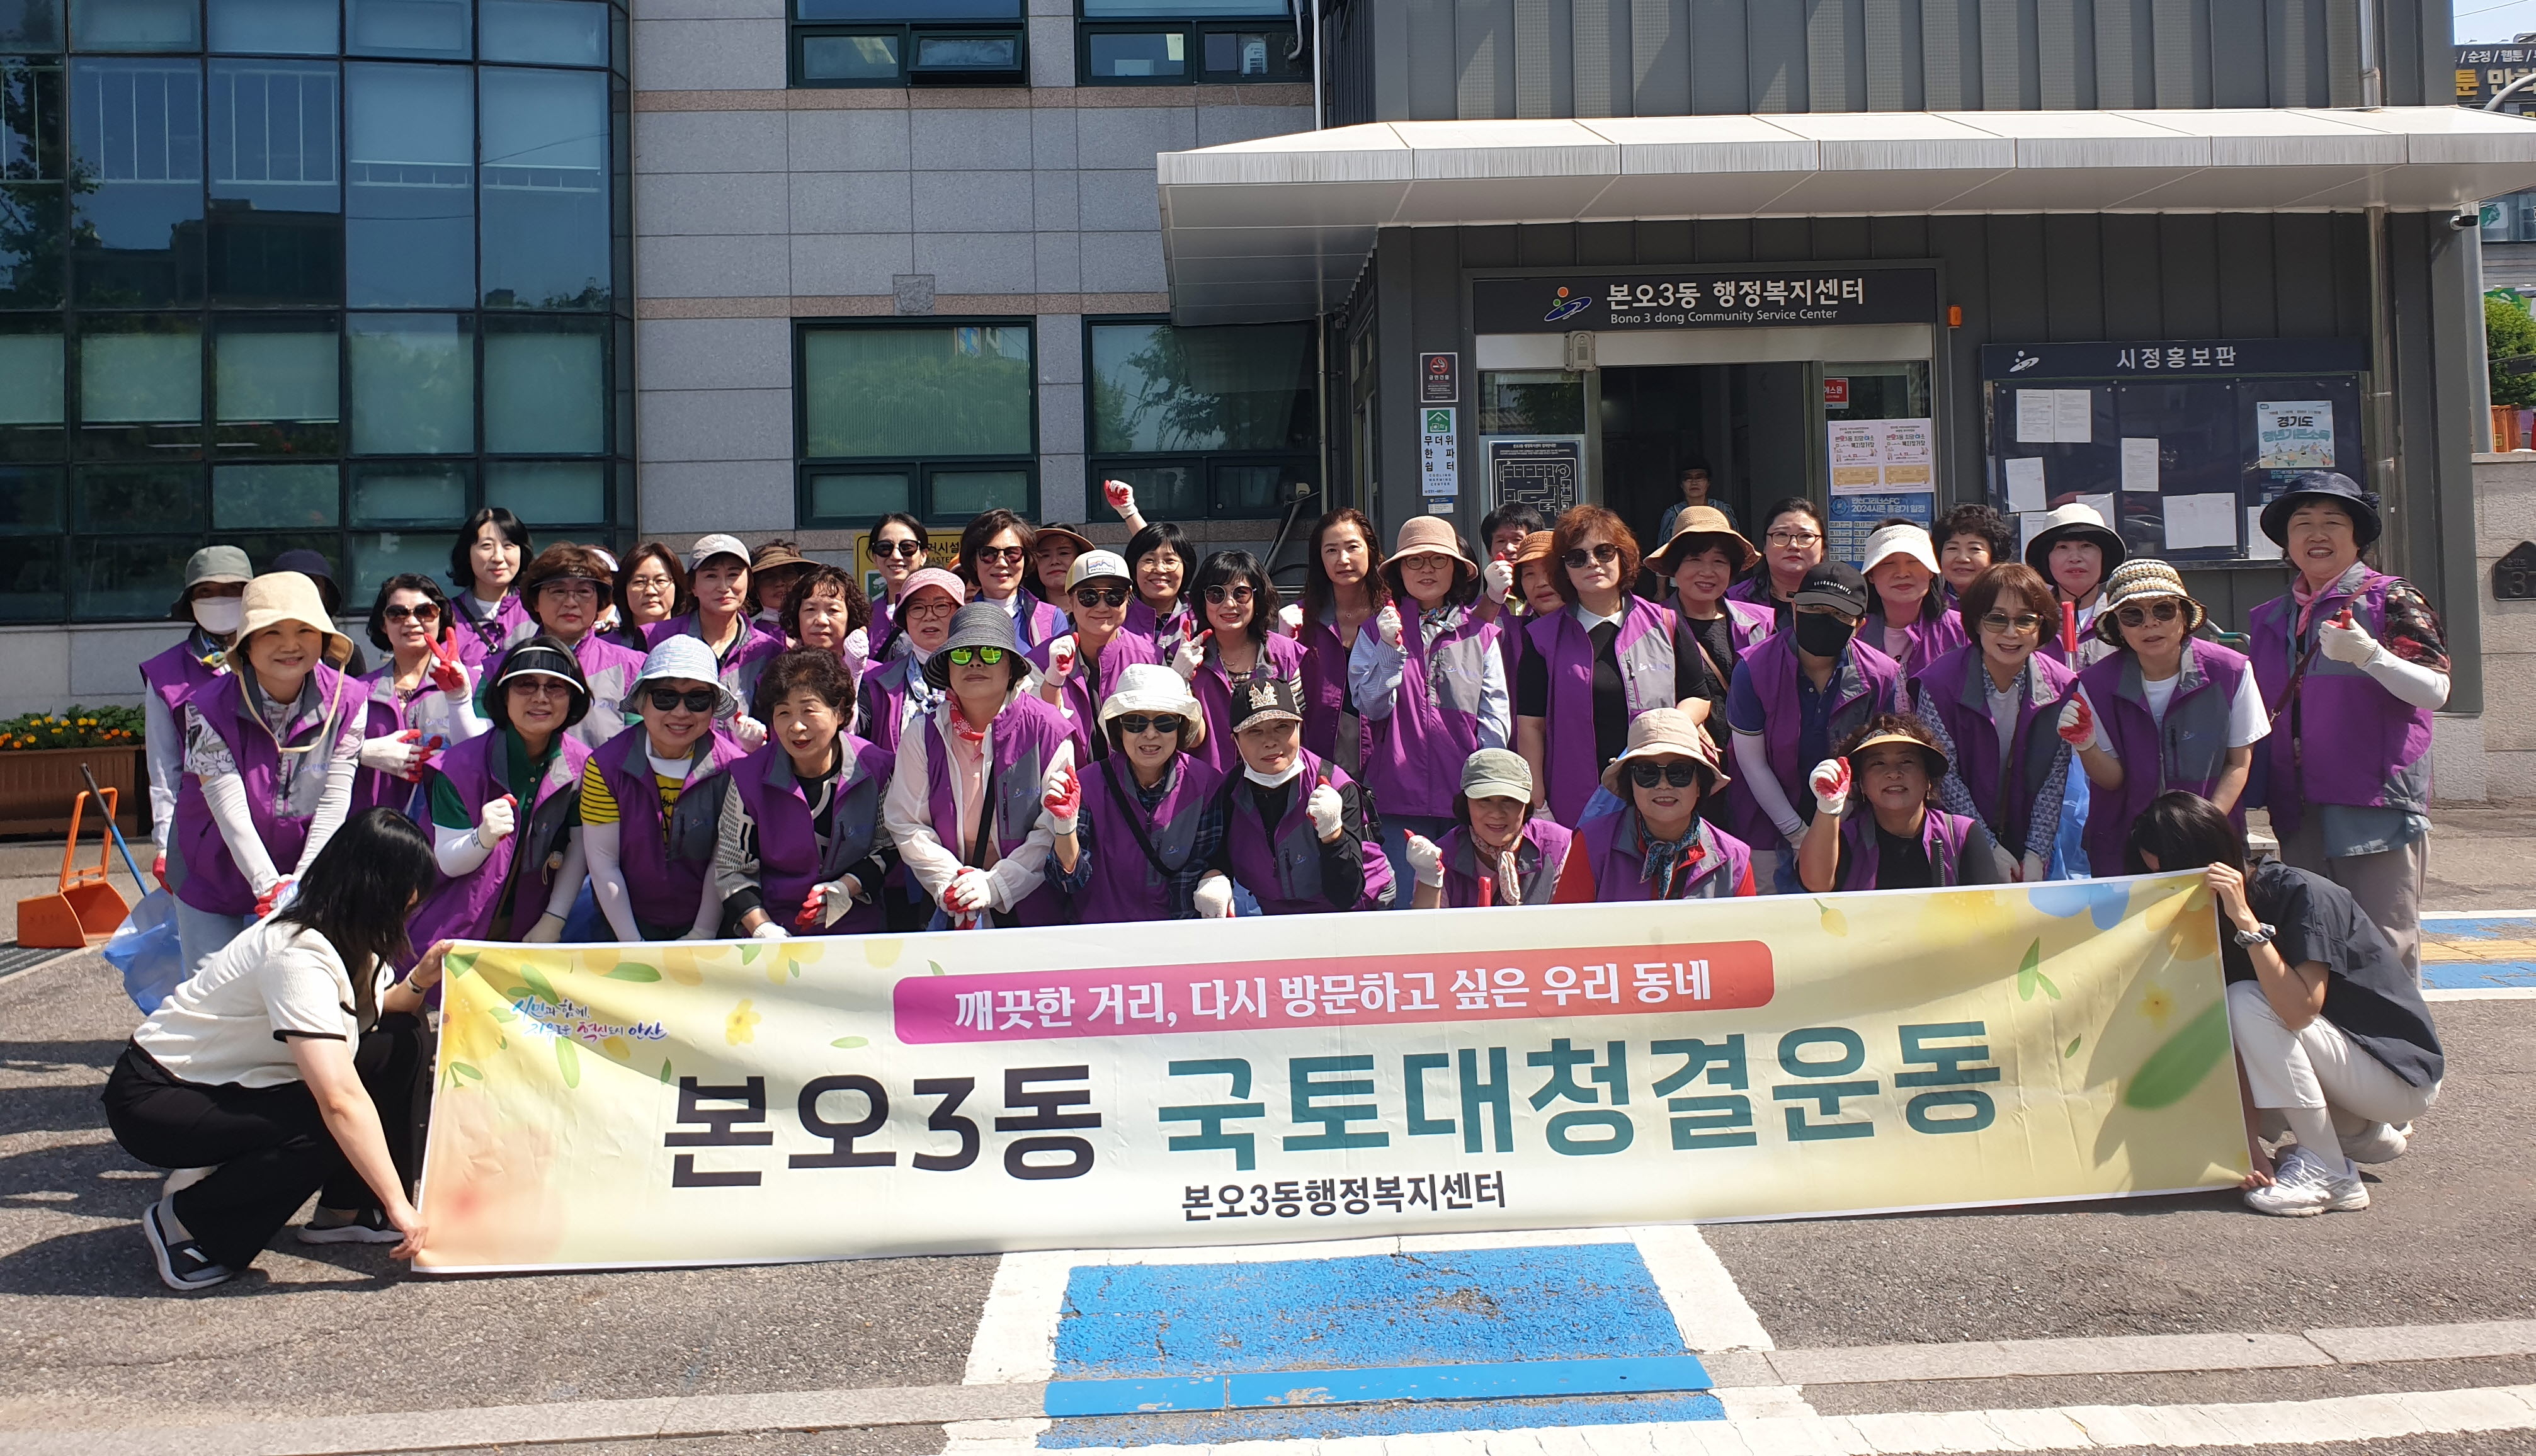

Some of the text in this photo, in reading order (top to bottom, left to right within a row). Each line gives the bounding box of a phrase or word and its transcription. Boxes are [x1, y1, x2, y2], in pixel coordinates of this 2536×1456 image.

[1606, 278, 1863, 310] 본오3동 행정복지센터
[1611, 309, 1838, 324] Bono 3 dong Community Service Center
[2117, 346, 2236, 370] 시정홍보판
[2277, 416, 2314, 428] 경기도
[1424, 435, 1453, 446] 무더위
[1851, 504, 1886, 513] 2024시즌
[955, 958, 1710, 1031] 깨끗한 거리, 다시 방문하고 싶은 우리 동네
[512, 996, 556, 1022] 시민과
[628, 1021, 668, 1040] 안산
[664, 1020, 2001, 1188] 본오3동 국토대청결운동
[1182, 1170, 1506, 1222] 본오3동행정복지센터
